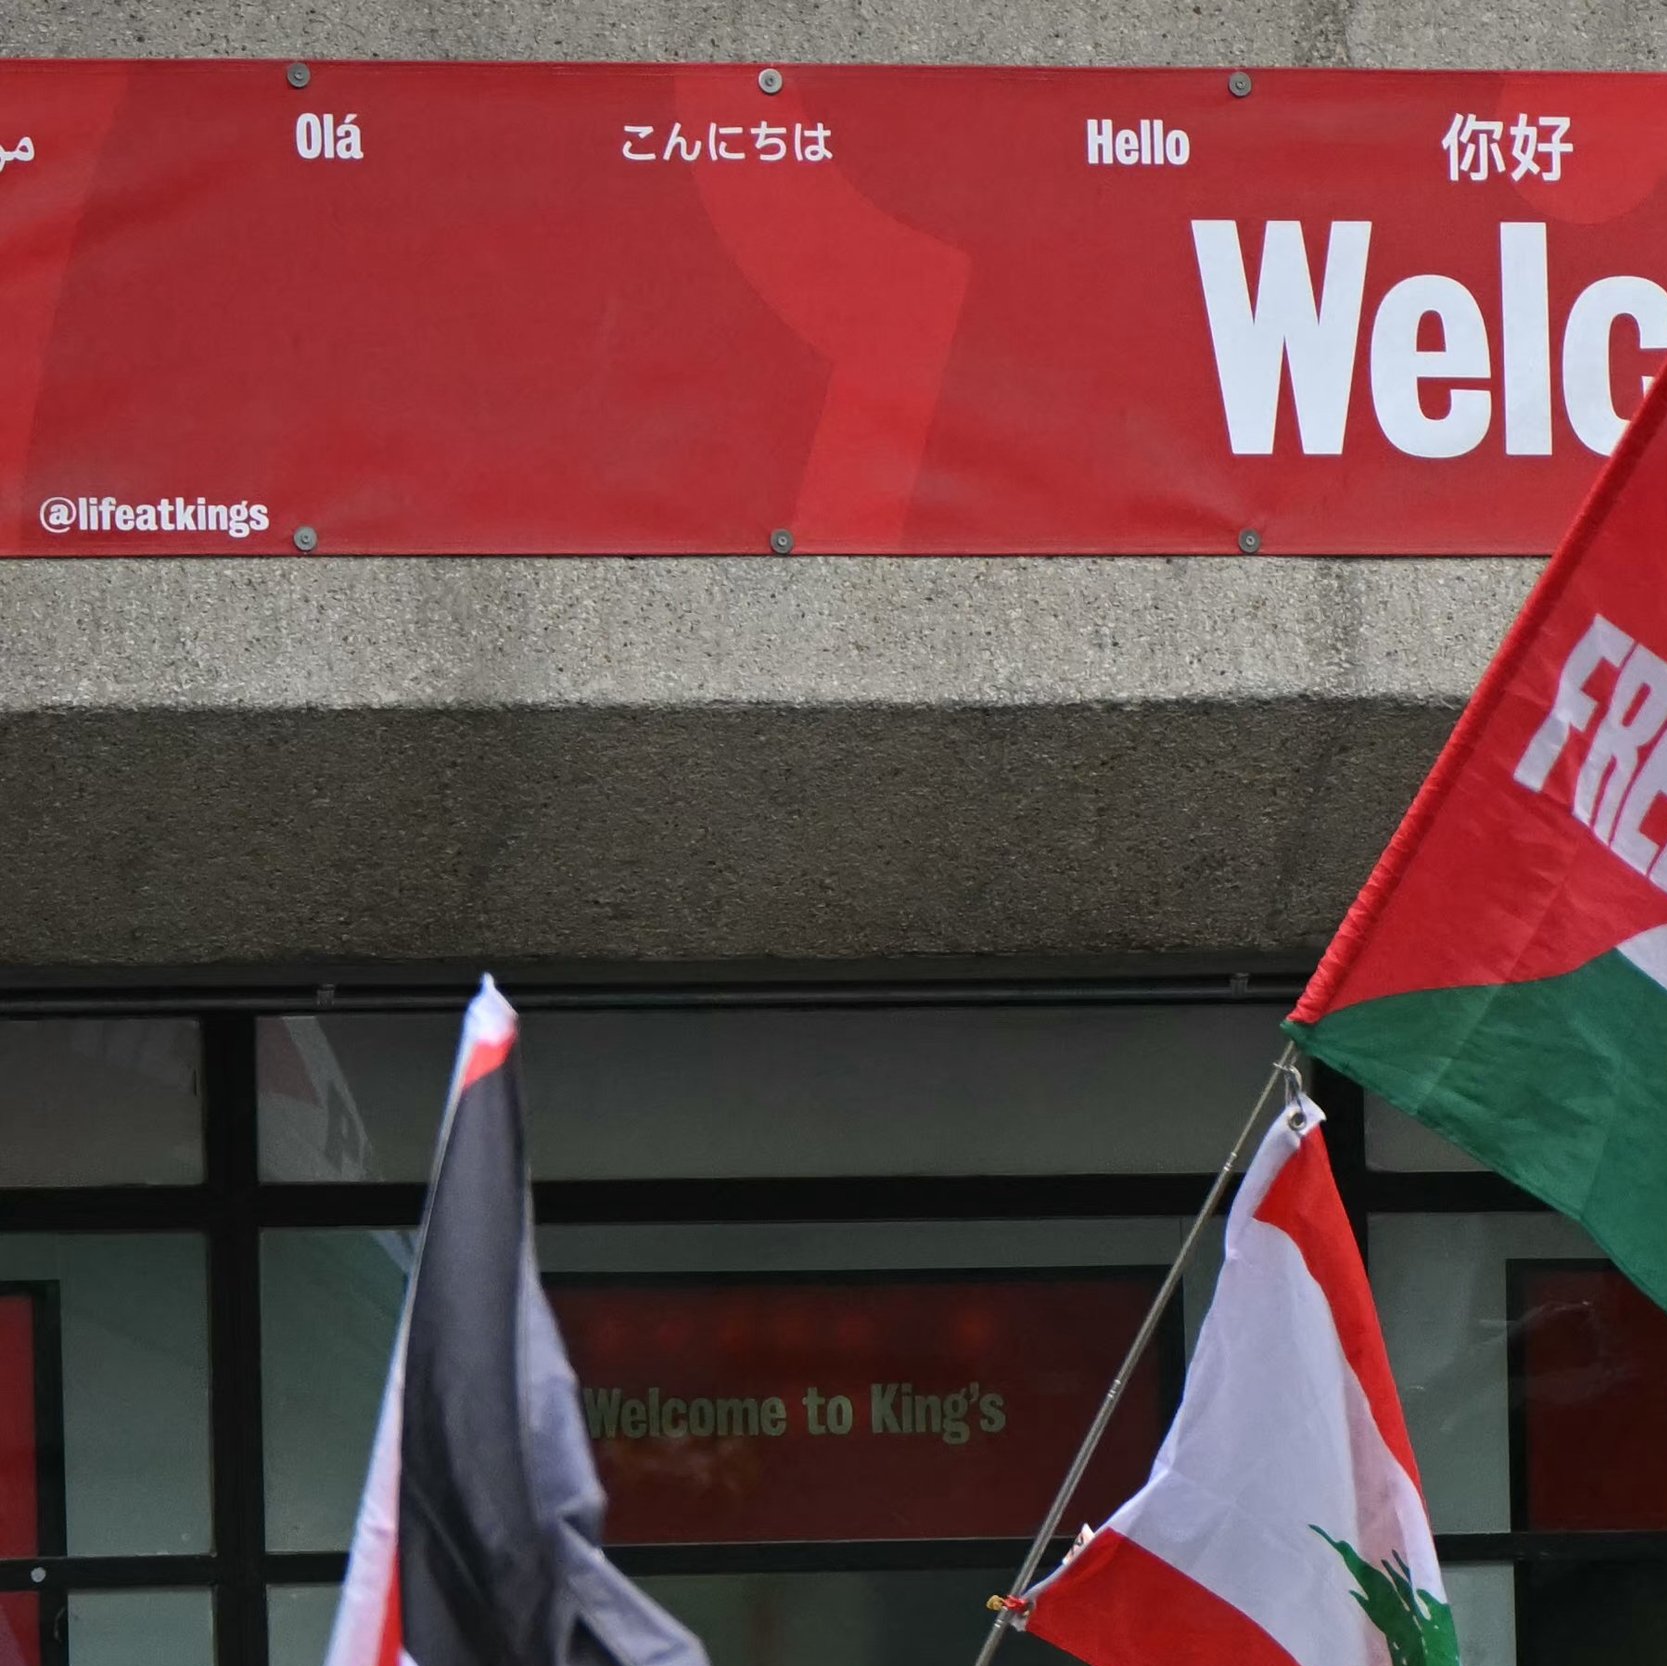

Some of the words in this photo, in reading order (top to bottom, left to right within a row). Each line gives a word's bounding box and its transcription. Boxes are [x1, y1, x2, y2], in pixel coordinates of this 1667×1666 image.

[295, 112, 364, 160] Olá
[622, 120, 833, 162] こんにちは
[1087, 118, 1190, 165] Hello
[1441, 112, 1574, 182] 你好
[39, 496, 270, 538] @lifeatkings
[583, 1386, 788, 1440] Welcome
[802, 1386, 854, 1436] to
[870, 1381, 1007, 1445] King's
